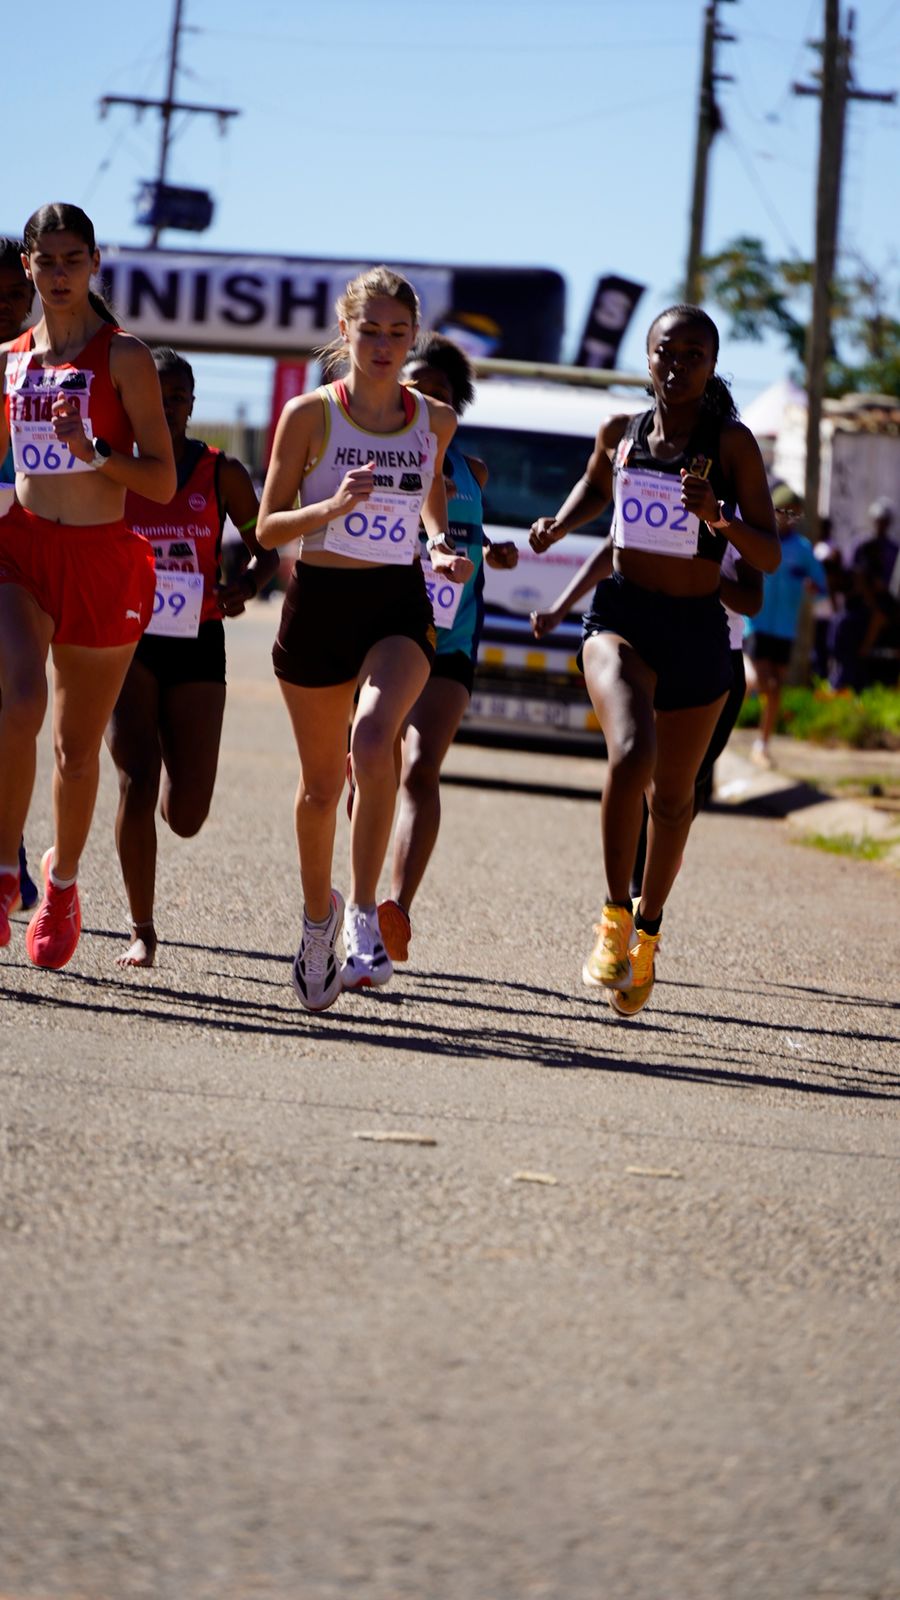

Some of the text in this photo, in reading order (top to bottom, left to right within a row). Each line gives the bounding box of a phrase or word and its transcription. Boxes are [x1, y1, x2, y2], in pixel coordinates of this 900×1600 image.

[100, 265, 329, 329] INISH
[373, 474, 394, 488] 2026
[344, 512, 406, 543] 056
[622, 498, 689, 532] 002
[132, 524, 211, 538] Running Club
[153, 592, 186, 617] 09
[425, 582, 455, 609] 30
